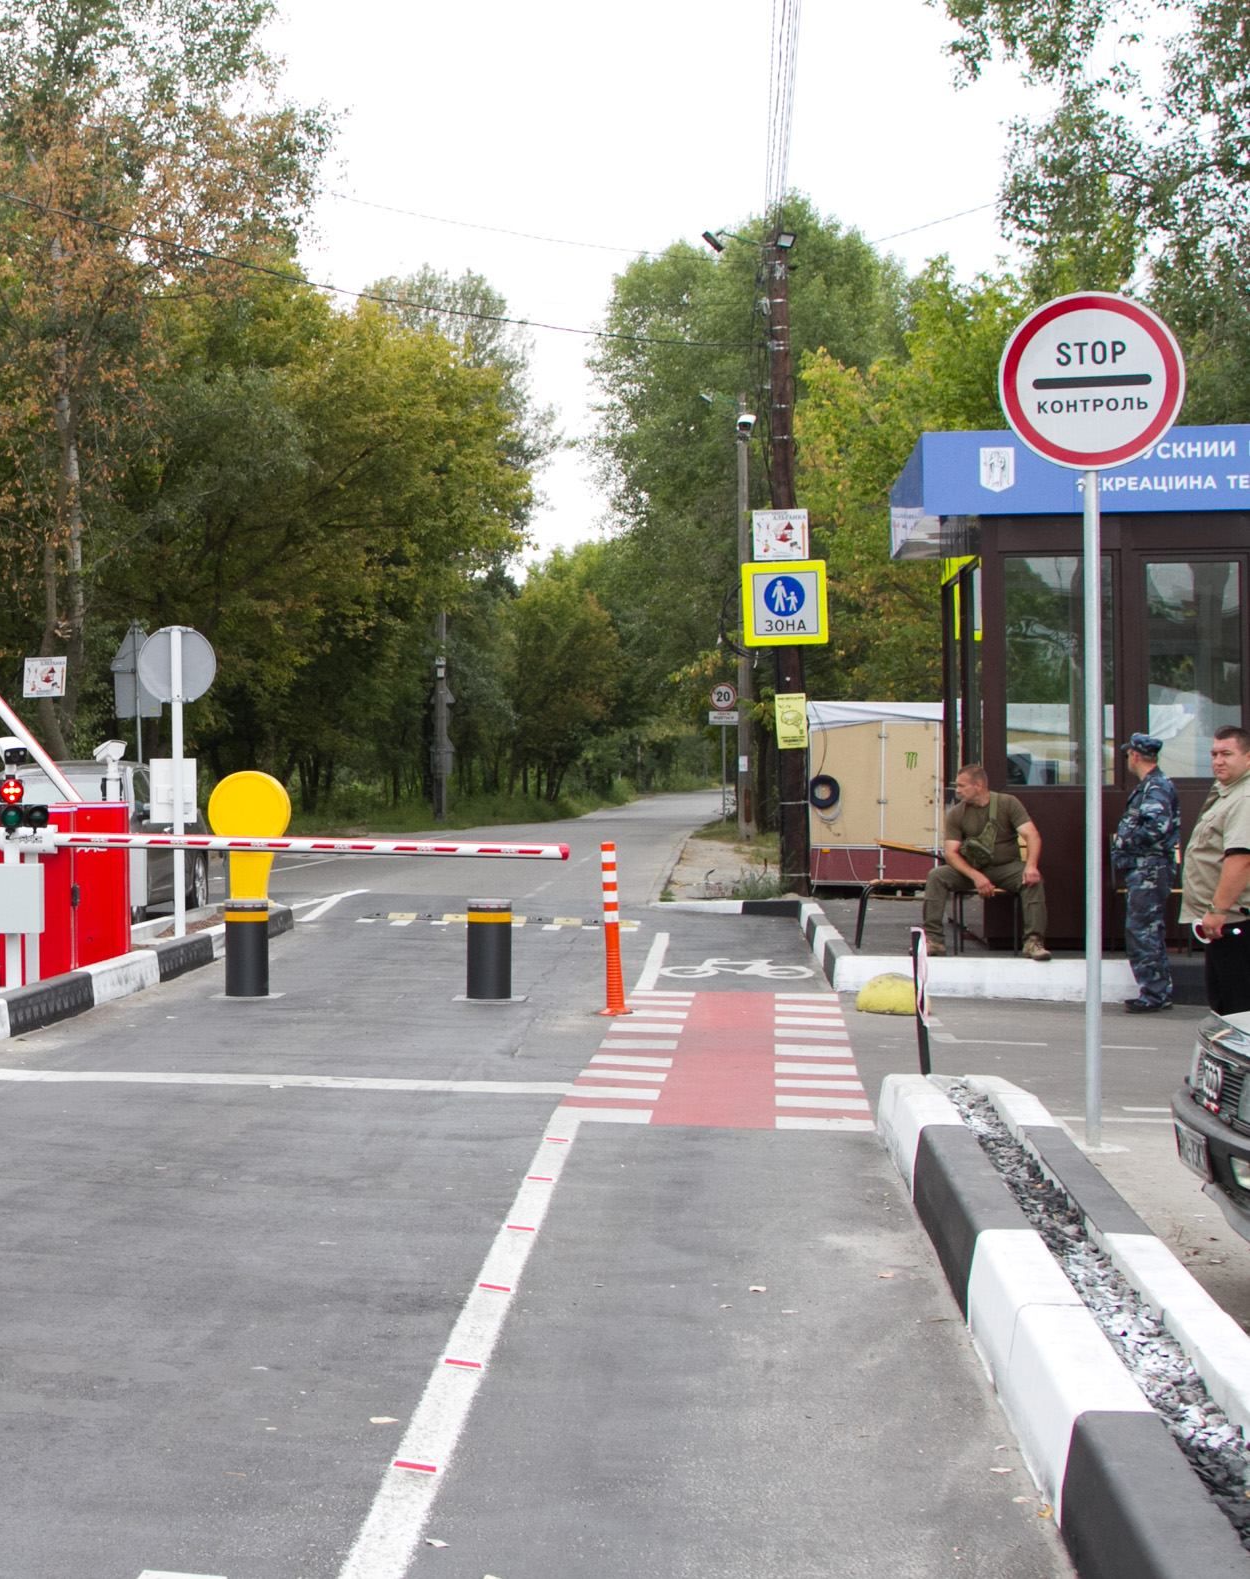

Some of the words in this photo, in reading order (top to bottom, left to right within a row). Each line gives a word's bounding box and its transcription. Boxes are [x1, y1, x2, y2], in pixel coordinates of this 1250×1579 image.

[1055, 340, 1126, 367] STOP
[1037, 397, 1149, 414] КОНТРОЛЬ
[764, 618, 807, 632] ЗОНА
[716, 691, 731, 702] 20
